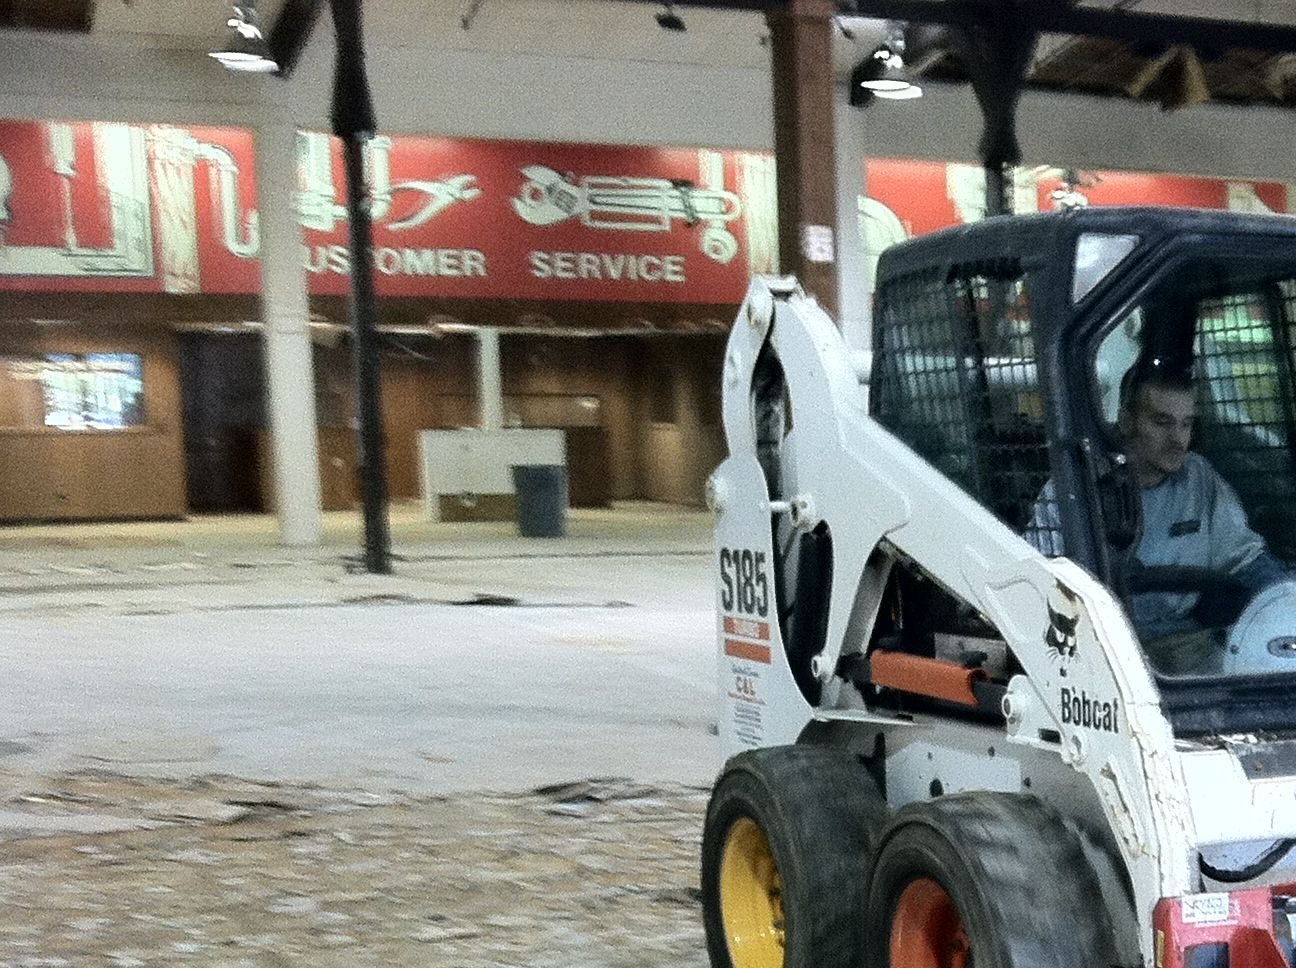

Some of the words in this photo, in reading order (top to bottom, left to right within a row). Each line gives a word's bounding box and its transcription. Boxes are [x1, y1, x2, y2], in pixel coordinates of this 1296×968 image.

[301, 245, 488, 277] USOMER
[529, 250, 688, 284] SERVICE
[720, 547, 768, 618] S185
[1061, 687, 1119, 734] Bobcat
